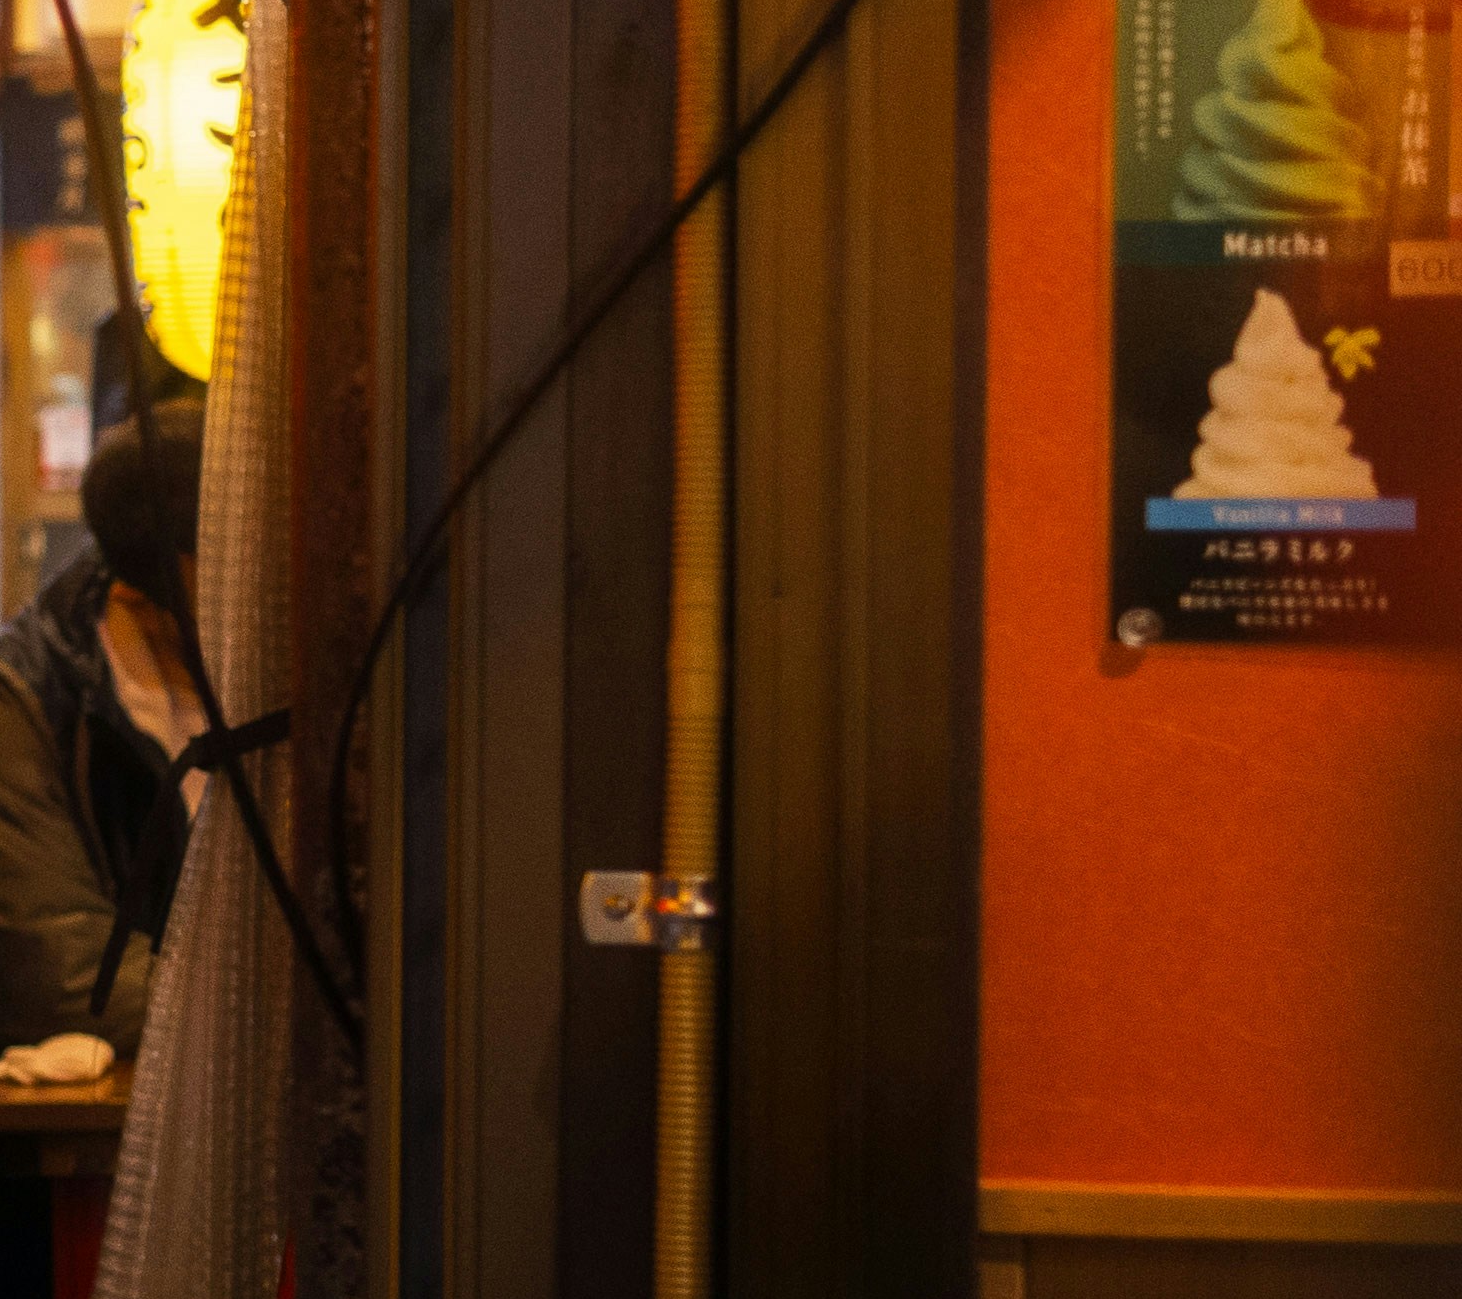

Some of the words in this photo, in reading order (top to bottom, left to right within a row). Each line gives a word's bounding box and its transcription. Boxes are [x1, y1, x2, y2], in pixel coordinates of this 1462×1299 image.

[1224, 231, 1329, 258] Matcha
[1204, 538, 1356, 563] バニラミルク
